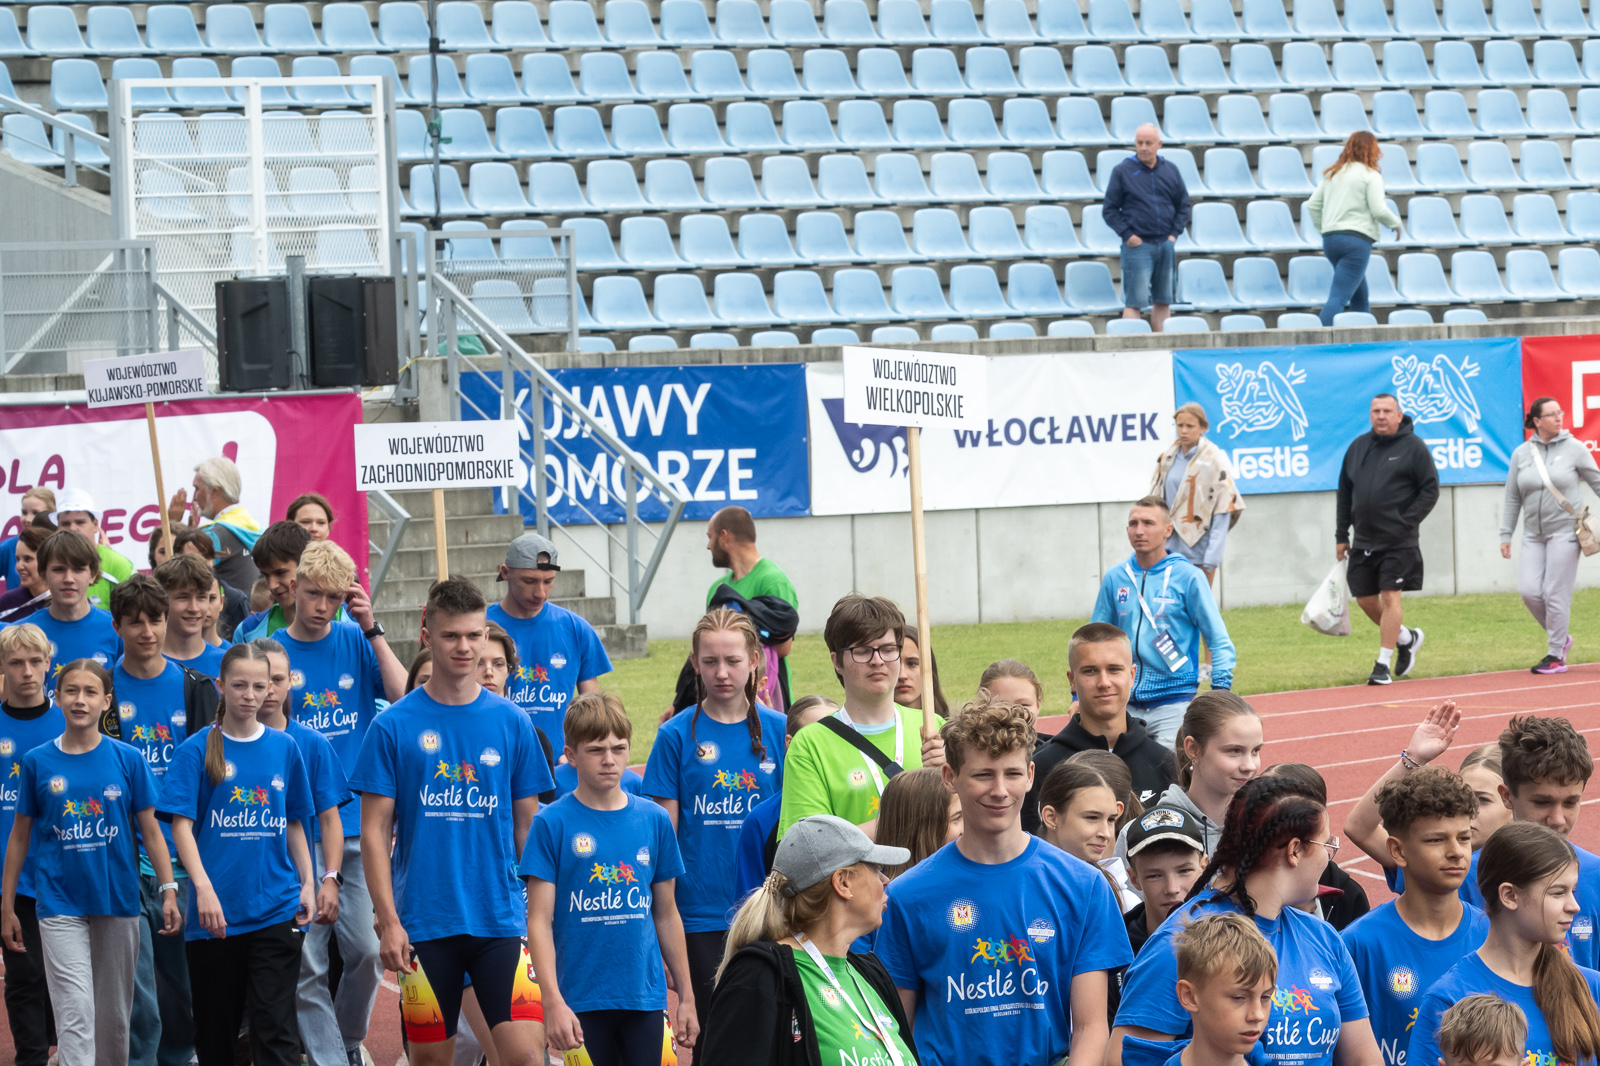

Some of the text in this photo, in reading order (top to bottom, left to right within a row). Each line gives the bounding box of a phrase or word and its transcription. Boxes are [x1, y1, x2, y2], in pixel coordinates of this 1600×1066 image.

[106, 361, 177, 382] WOJEWÓDZTWO
[872, 357, 957, 386] WOJEWÓDZTWO
[88, 377, 204, 403] KUJAWSKO-POMORSKIE
[865, 386, 964, 419] WIELKOPOLSKIE
[388, 433, 485, 456] WOJEWÓDZTWO
[361, 459, 515, 485] ZACHODNIOPOMORSKIE
[539, 685, 567, 710] Cup
[332, 707, 359, 730] Cup
[466, 786, 499, 816] Cup
[694, 793, 744, 815] Nestlé
[210, 808, 287, 835] Nestlé Cup
[569, 887, 624, 913] Nestlé
[946, 968, 1016, 1003] Nestlé
[1267, 1016, 1302, 1046] stlé
[1306, 1016, 1340, 1054] Cup
